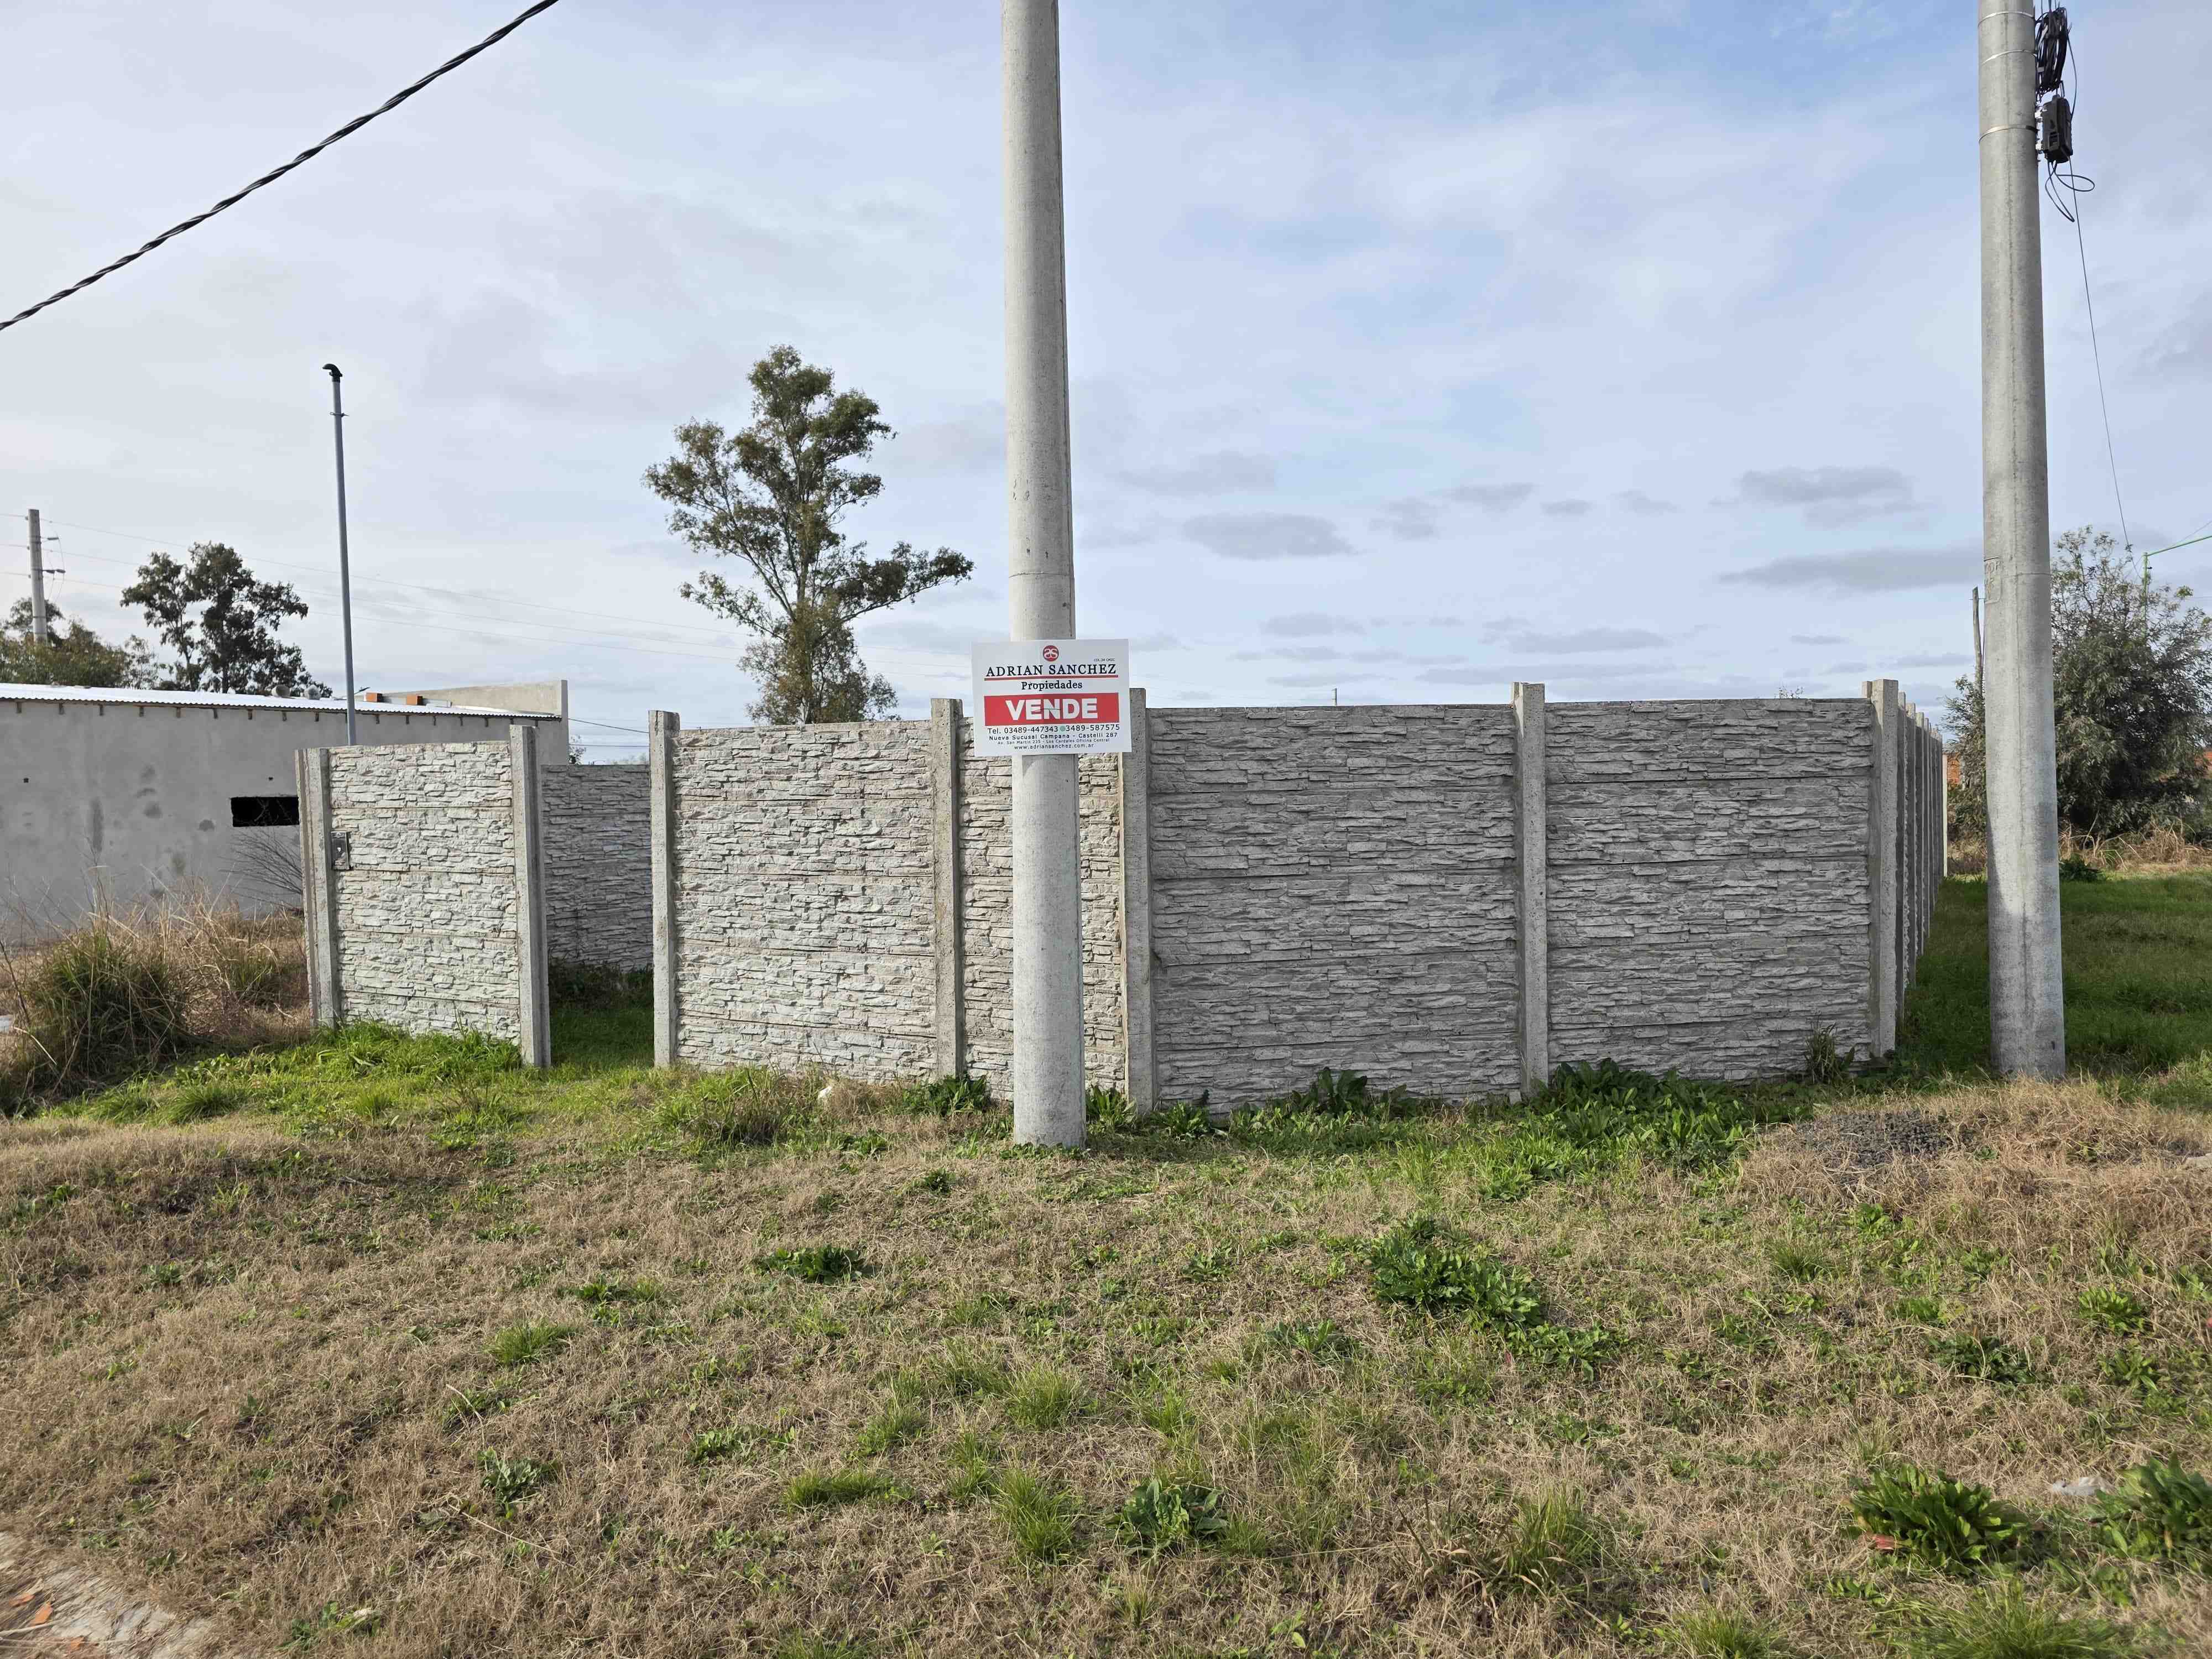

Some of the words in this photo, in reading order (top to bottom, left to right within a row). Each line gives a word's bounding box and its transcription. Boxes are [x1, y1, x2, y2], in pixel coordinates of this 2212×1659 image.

[985, 665, 1043, 676] ADRIAN
[1048, 664, 1116, 675] SANCHEZ
[1021, 680, 1082, 691] Propiedades
[1005, 698, 1098, 720] VENDE
